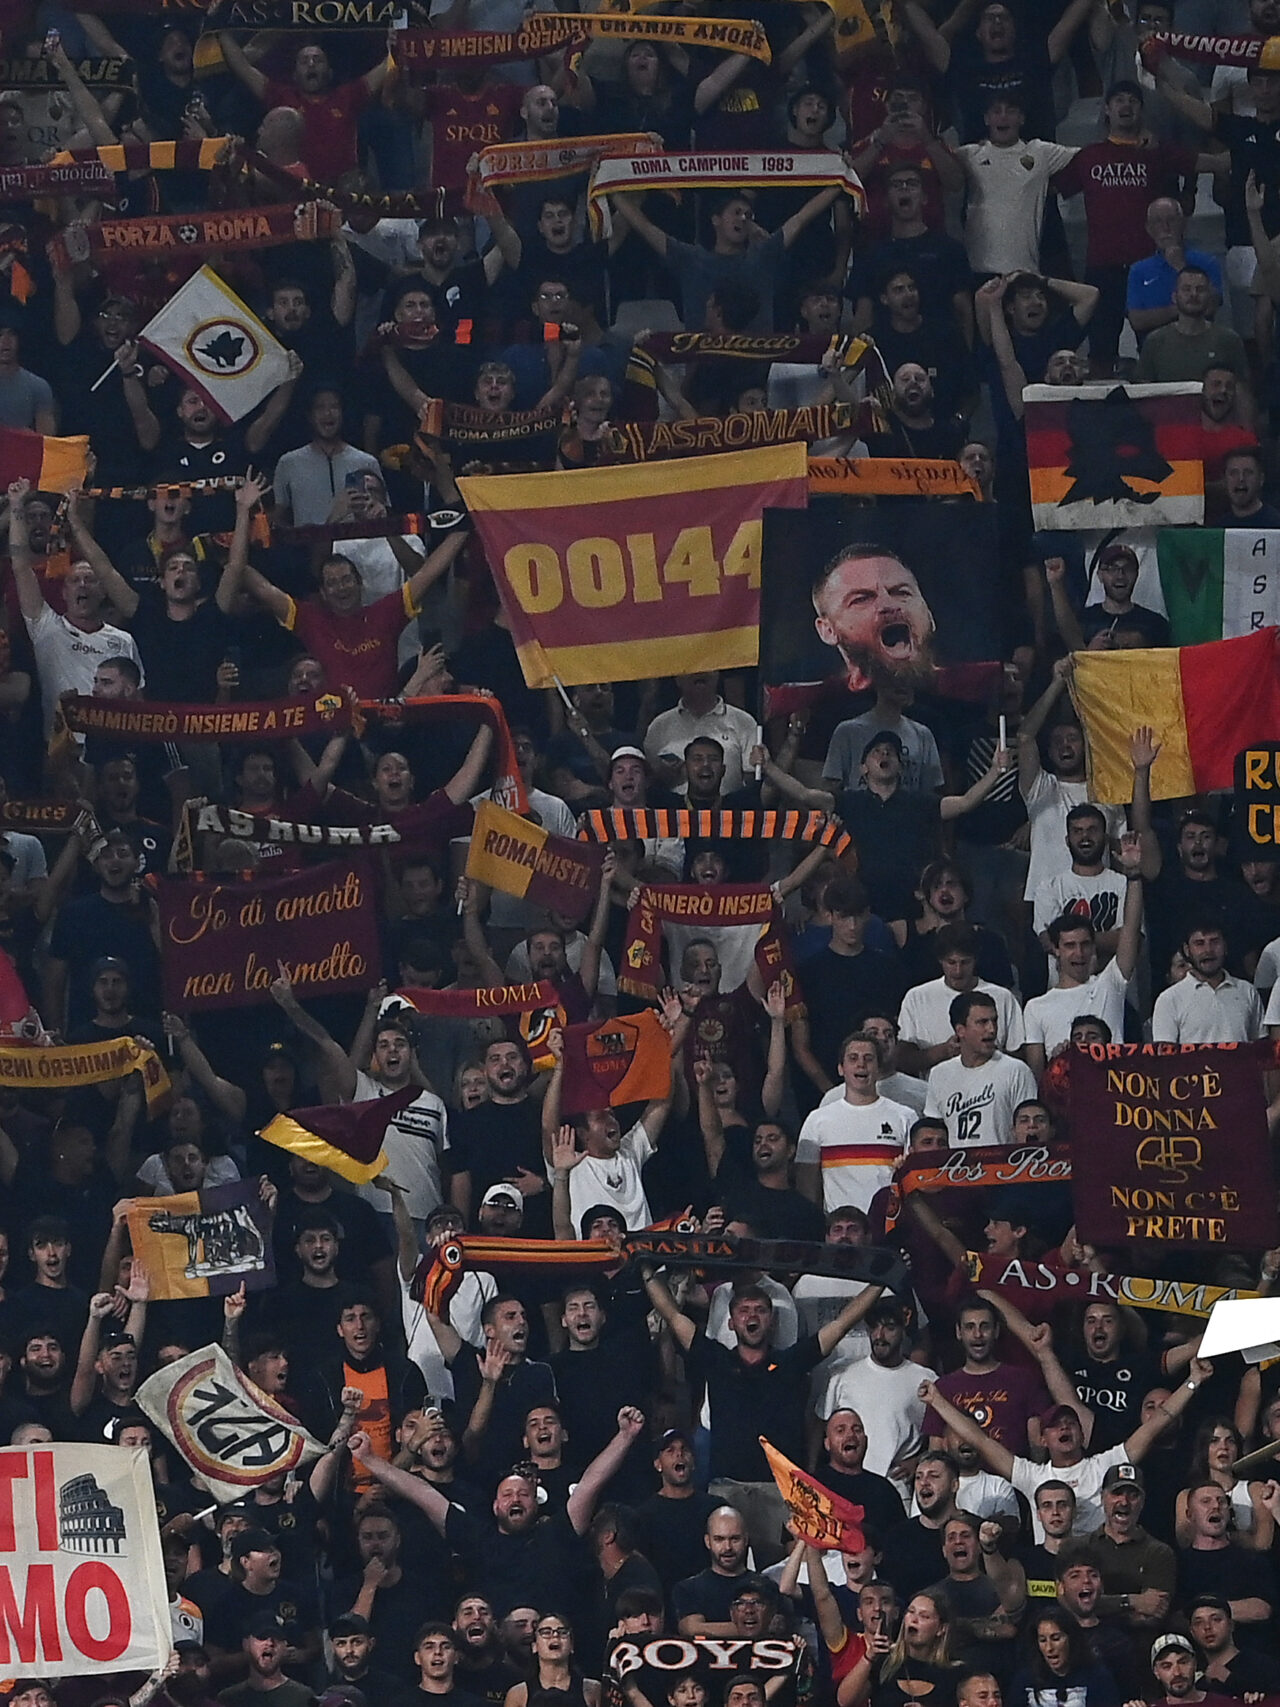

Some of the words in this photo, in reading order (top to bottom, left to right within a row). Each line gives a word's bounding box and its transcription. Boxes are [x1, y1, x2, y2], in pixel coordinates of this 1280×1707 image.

[292, 1, 396, 24] ROMA
[693, 23, 767, 51] AMORE
[446, 124, 501, 142] SPQR
[631, 158, 671, 175] ROMA
[678, 156, 750, 173] CAMPIONE
[761, 156, 794, 172] 1983
[1092, 163, 1148, 181] QATAR
[1102, 176, 1148, 187] AIRWAYS
[102, 225, 175, 249] FORZA
[203, 218, 271, 243] ROMA
[183, 711, 260, 735] INSIEME
[263, 709, 277, 728] A
[284, 706, 305, 729] TE
[196, 803, 256, 836] AS
[239, 896, 266, 928] di
[275, 871, 365, 922] amarti
[183, 970, 236, 998] non
[244, 952, 272, 991] la
[475, 982, 542, 1008] ROMA
[1107, 1069, 1161, 1101] NON
[1169, 1065, 1223, 1101] C'È
[946, 1082, 996, 1119] Russell
[957, 1109, 983, 1141] 02
[1113, 1100, 1219, 1132] DONNA
[1111, 1185, 1176, 1212] NON
[1184, 1185, 1241, 1213] C'È
[1126, 1215, 1228, 1243] PRETE
[997, 1258, 1058, 1291] AS
[1077, 1385, 1129, 1412] SPQR
[1031, 1583, 1056, 1594] CALVIN
[609, 1637, 795, 1678] BOYS
